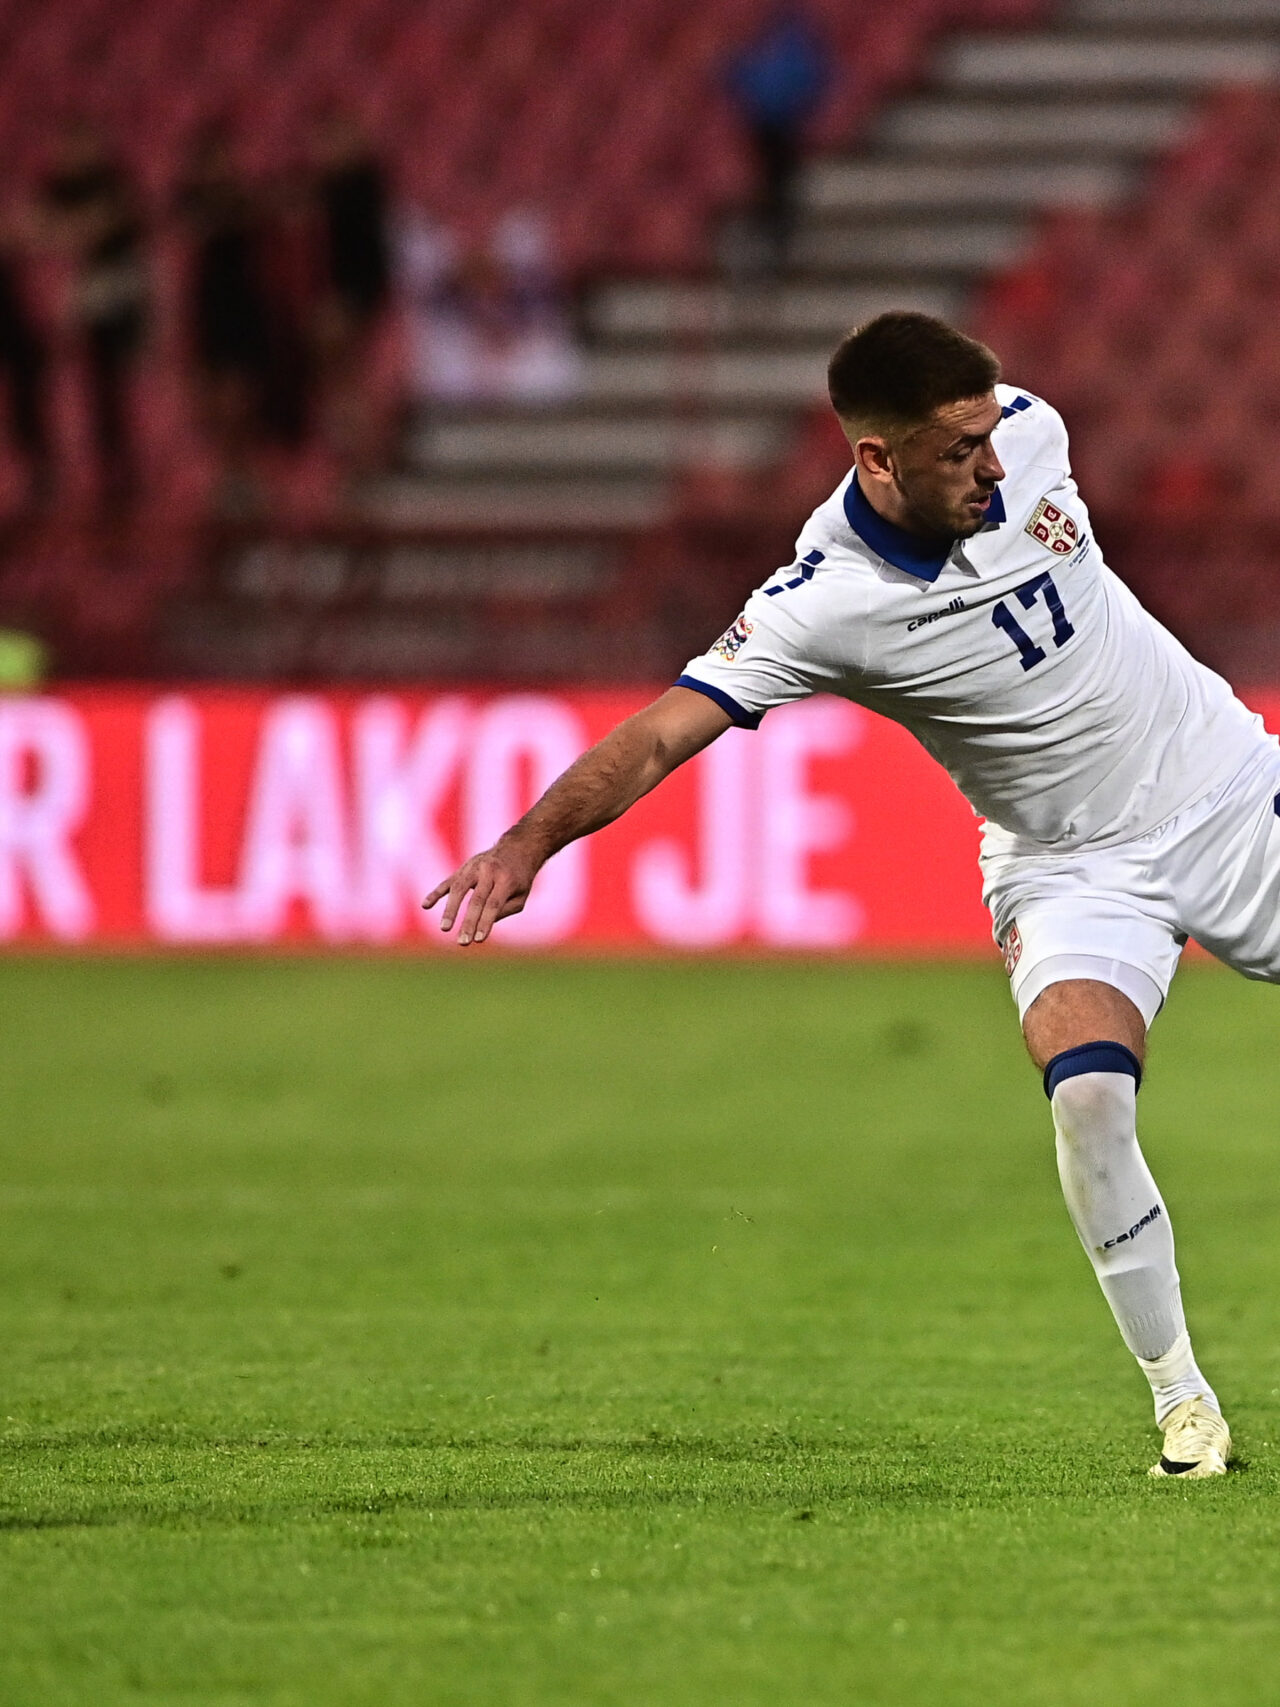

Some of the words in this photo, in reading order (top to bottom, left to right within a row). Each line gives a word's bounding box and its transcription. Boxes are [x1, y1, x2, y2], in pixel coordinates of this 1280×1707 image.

[991, 571, 1075, 672] 17
[144, 695, 590, 946] LAKO
[631, 692, 866, 946] JE
